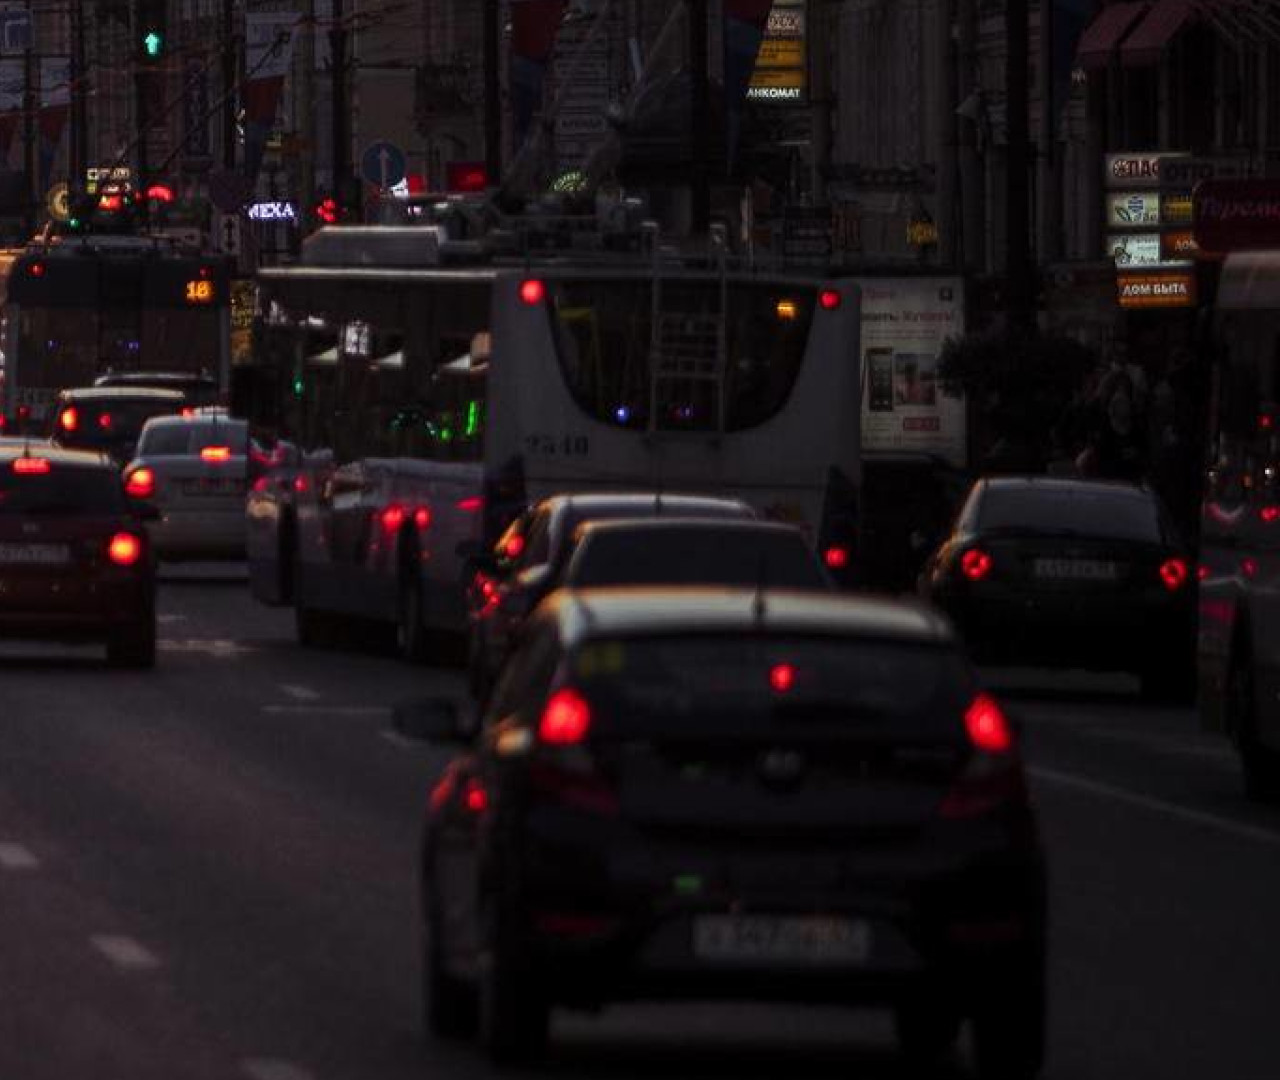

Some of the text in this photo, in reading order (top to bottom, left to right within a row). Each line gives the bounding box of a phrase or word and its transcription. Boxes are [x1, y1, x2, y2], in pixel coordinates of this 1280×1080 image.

[746, 88, 800, 98] АНКОМАТ
[1122, 282, 1187, 297] ДОМ БЫТА
